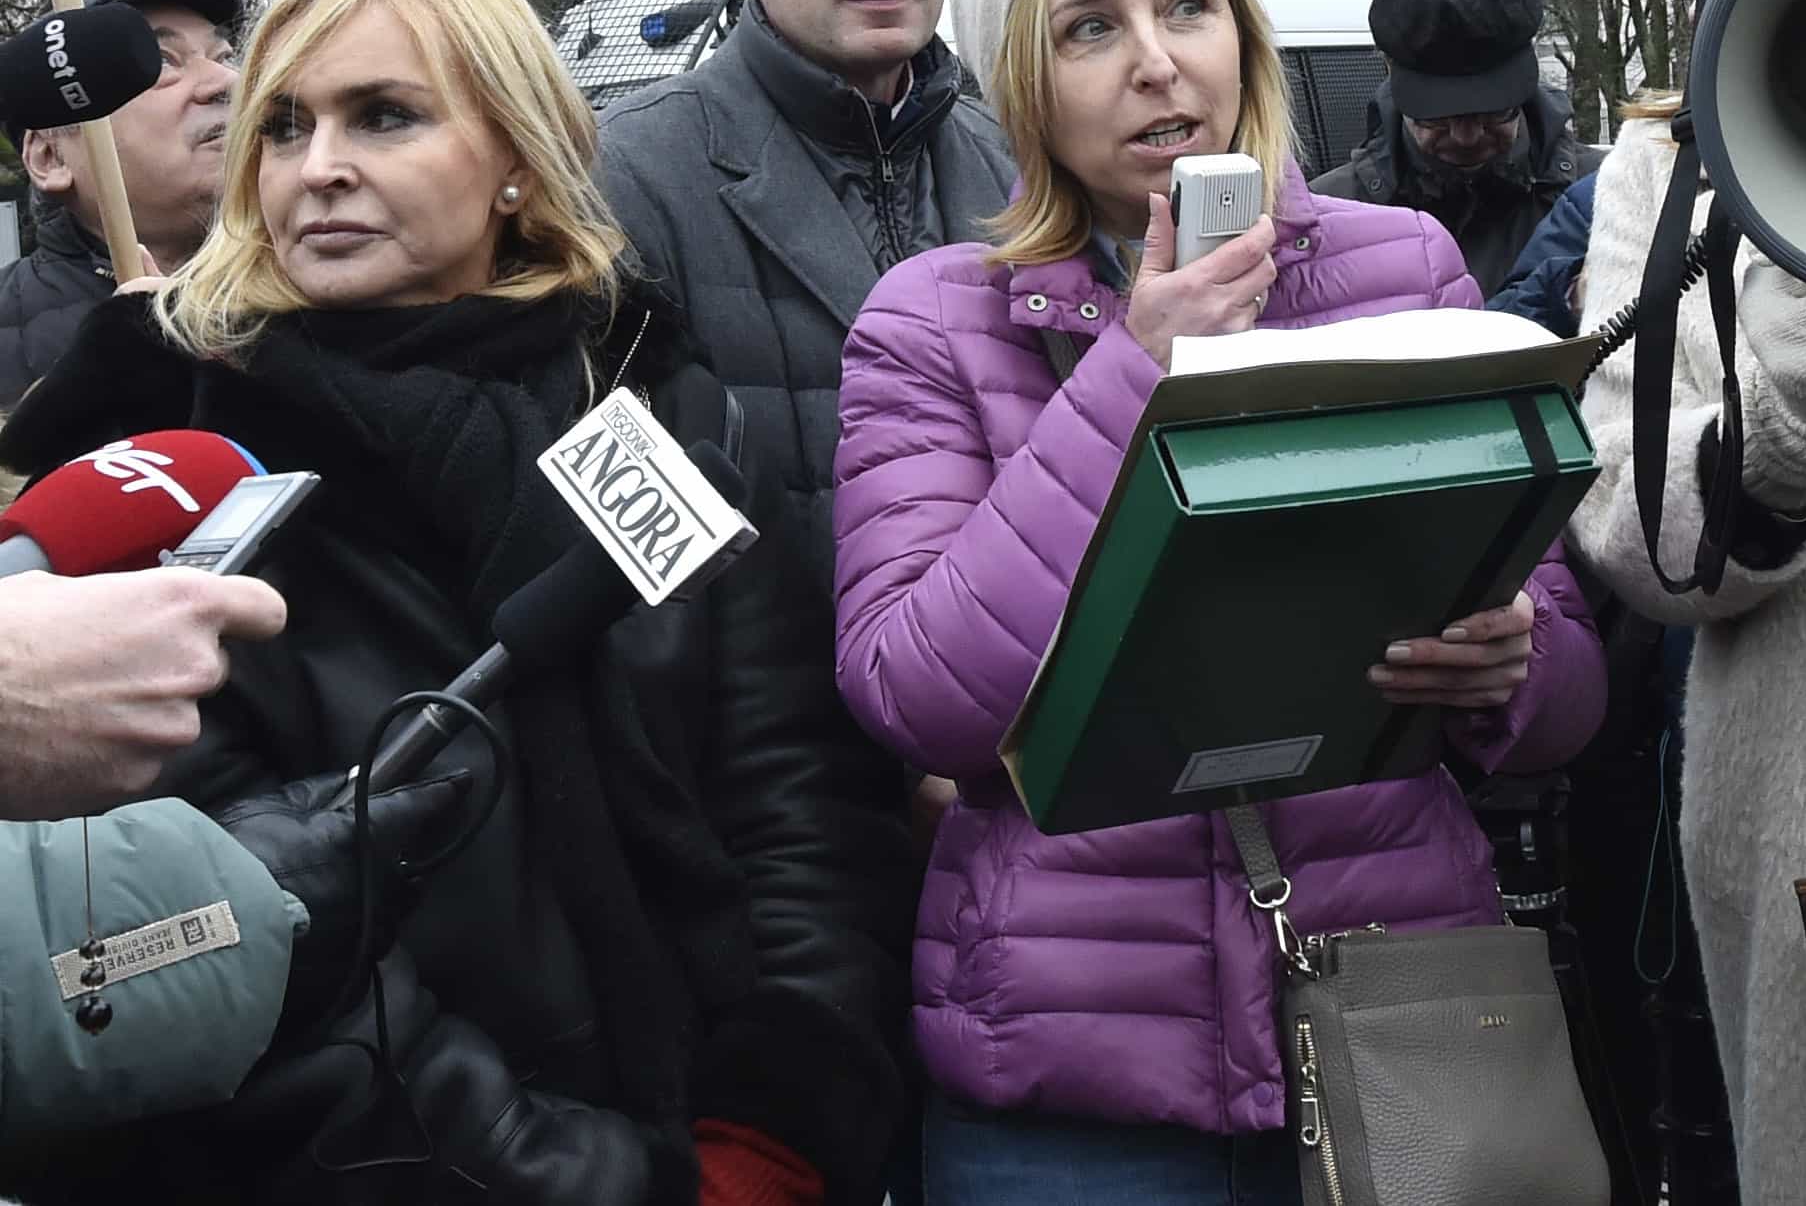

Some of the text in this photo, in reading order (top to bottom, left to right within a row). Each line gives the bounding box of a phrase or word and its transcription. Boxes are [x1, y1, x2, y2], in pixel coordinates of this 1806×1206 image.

[44, 19, 91, 109] onet TV
[558, 428, 696, 582] ANGORA
[101, 938, 176, 972] RESERVE
